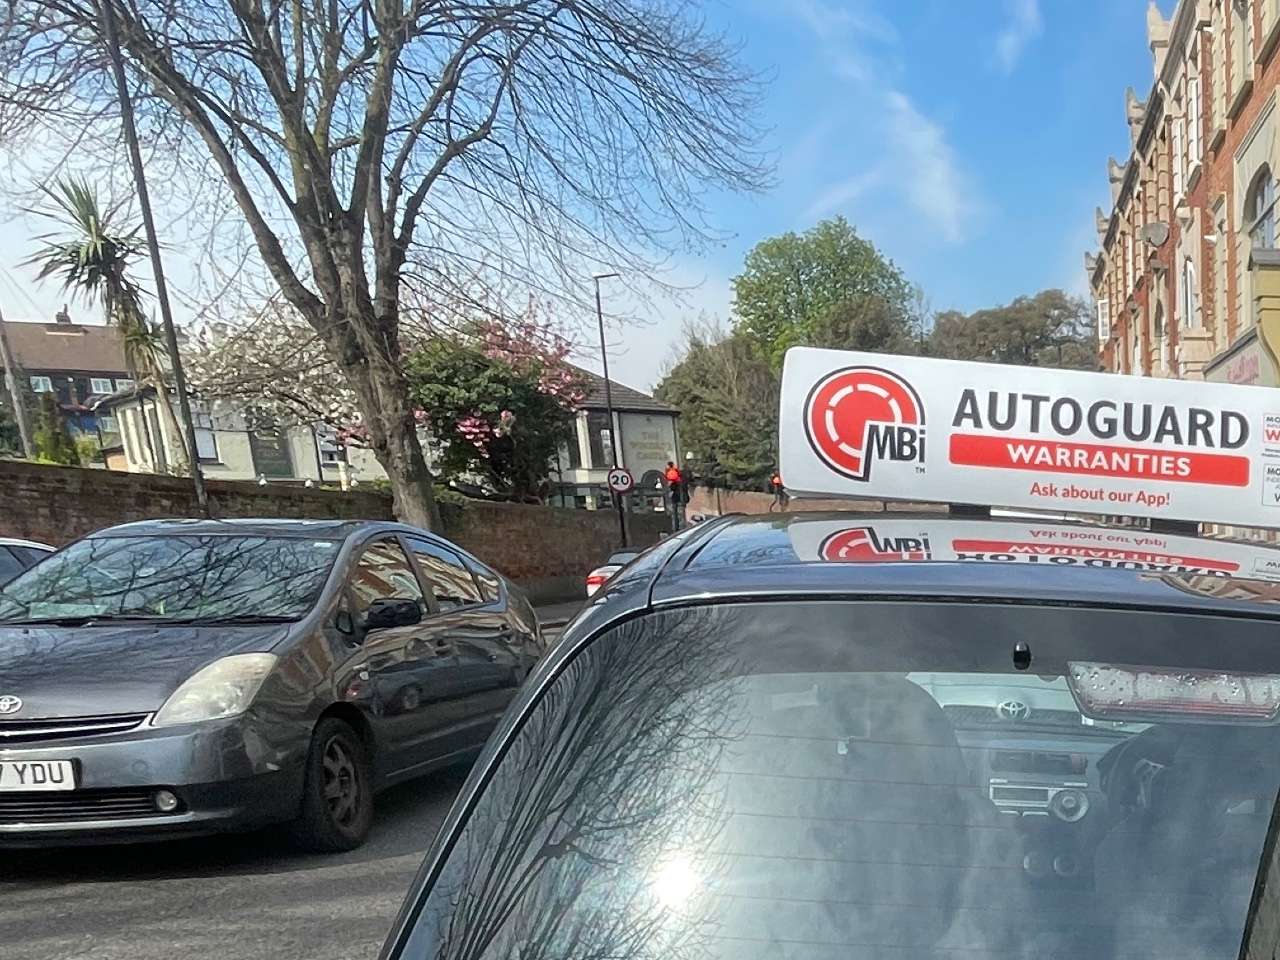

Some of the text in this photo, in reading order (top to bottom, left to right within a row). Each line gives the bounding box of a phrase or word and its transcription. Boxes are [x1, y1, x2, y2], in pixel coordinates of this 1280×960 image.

[952, 388, 1250, 450] AUTOGUARD
[1006, 442, 1191, 477] WARRANTIES
[611, 474, 629, 486] 20
[1030, 482, 1171, 507] Ask about our App!
[12, 763, 64, 785] YDU
